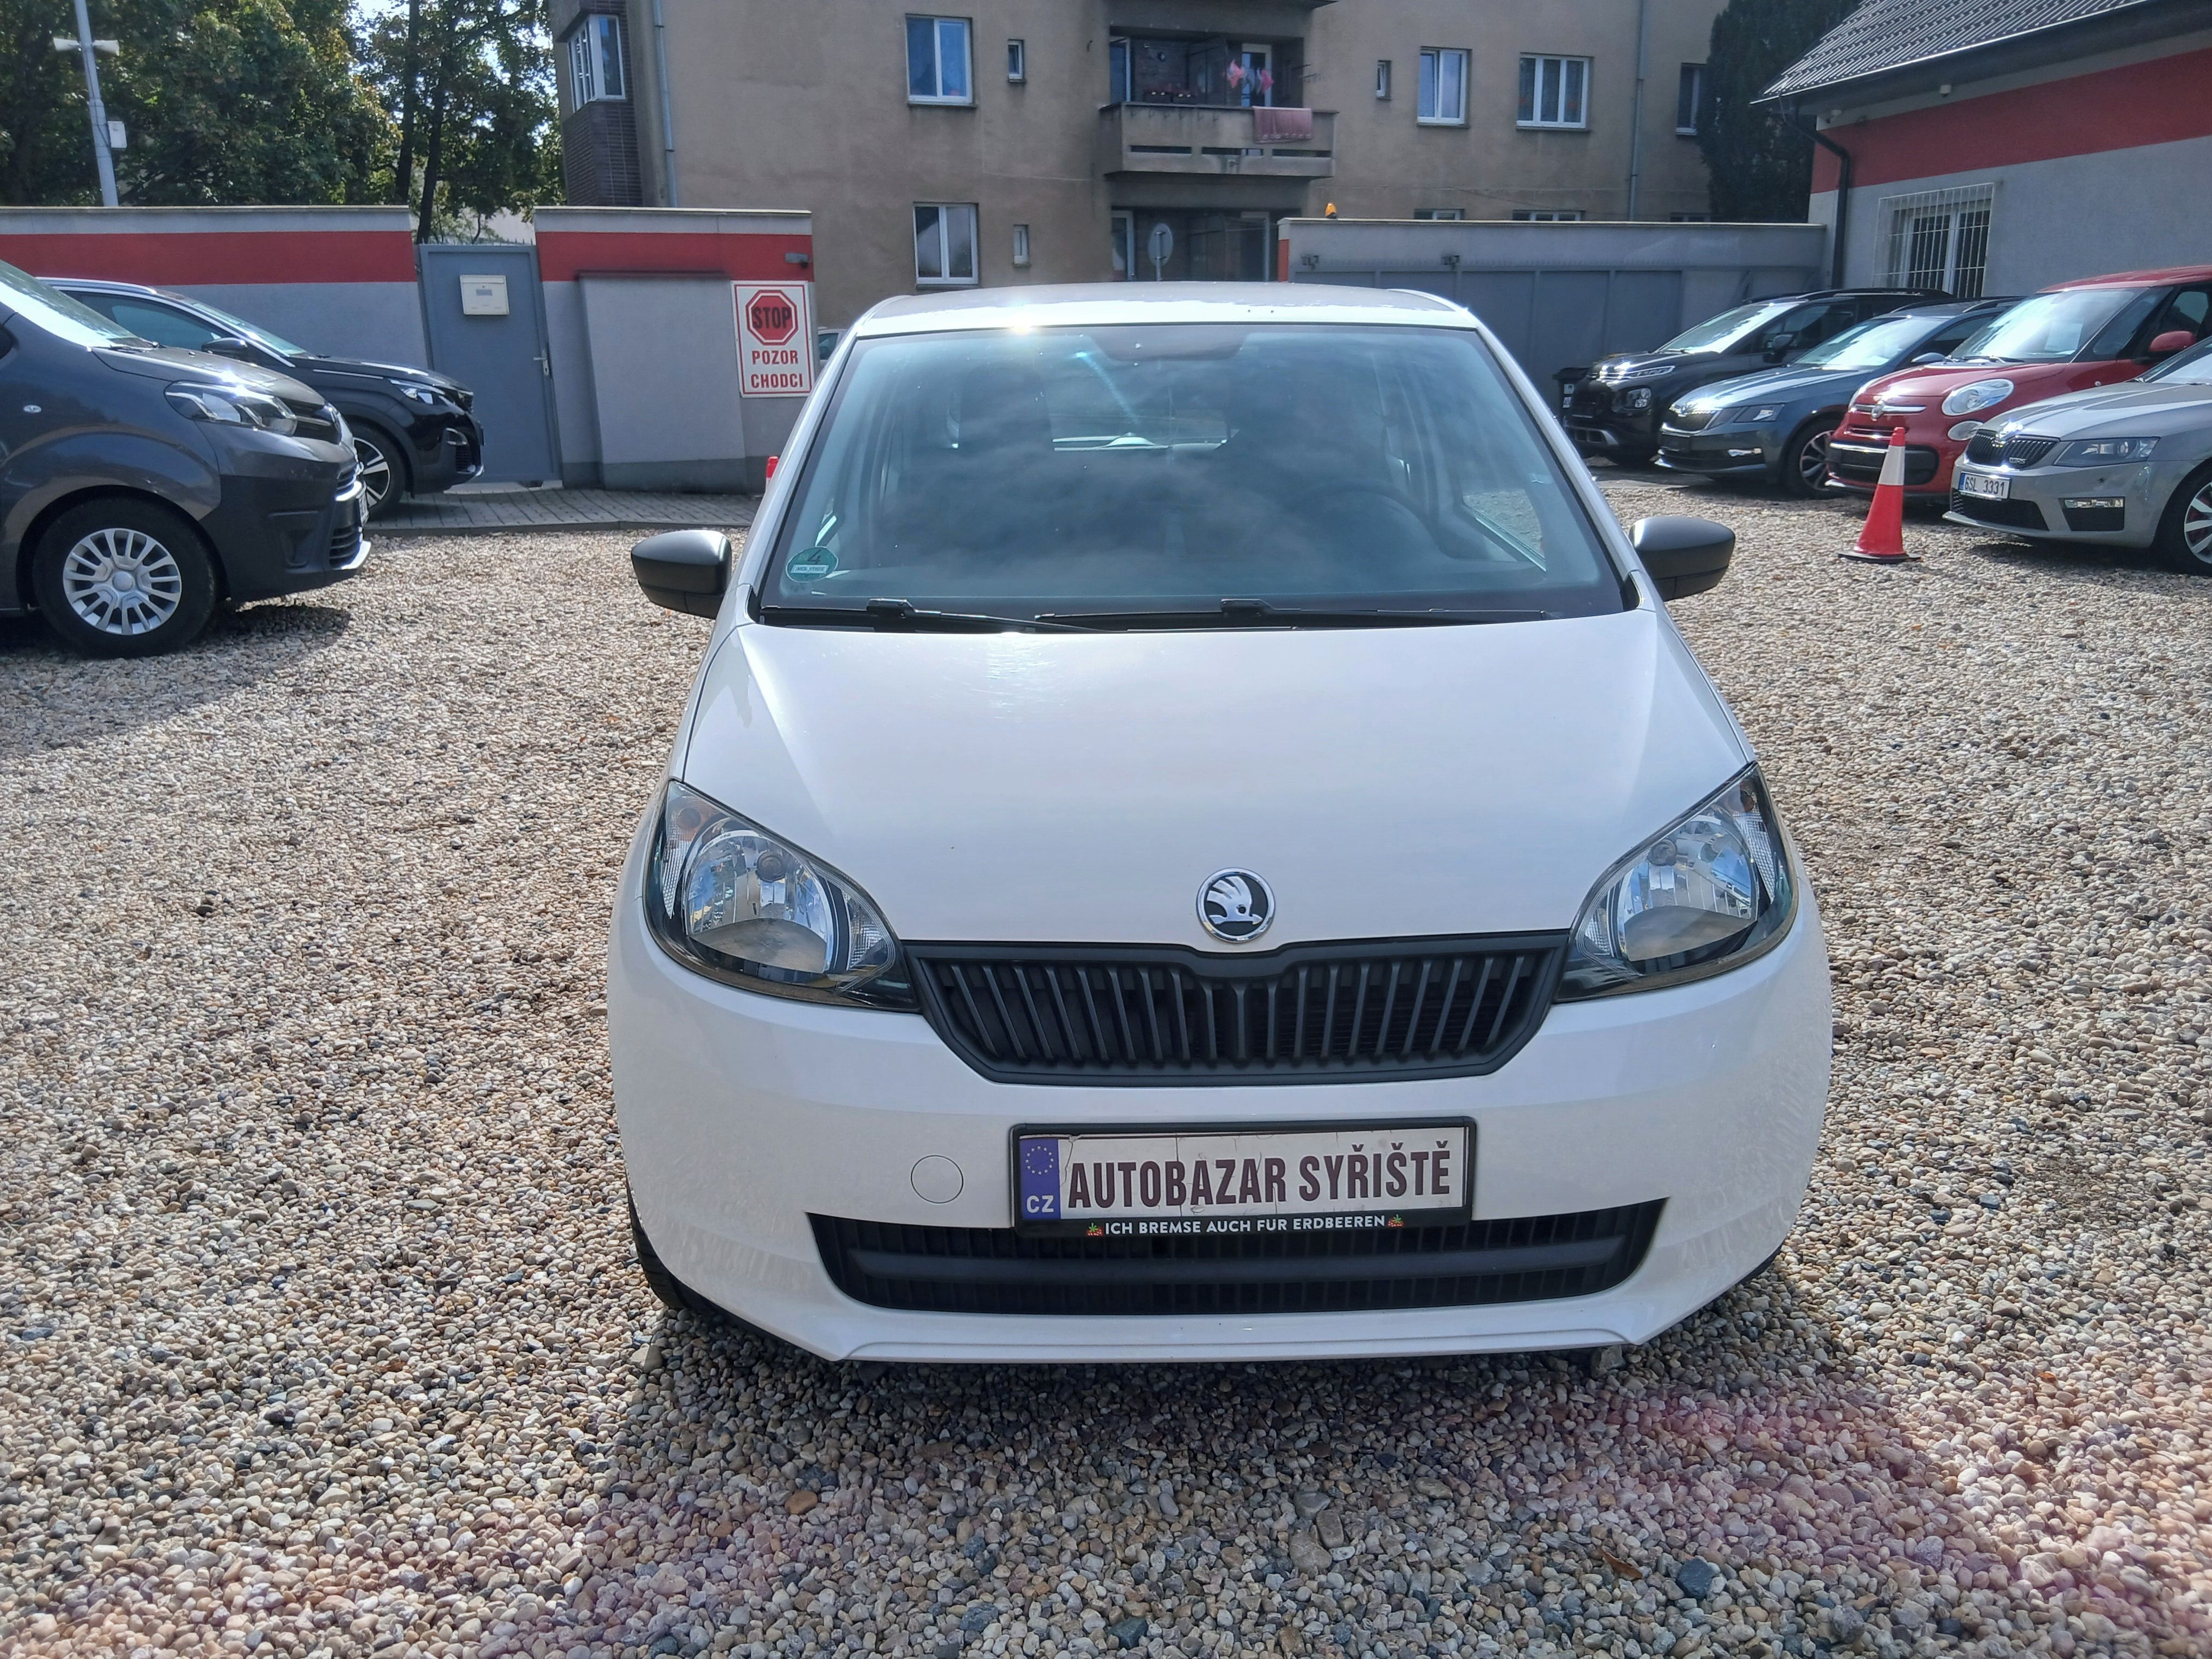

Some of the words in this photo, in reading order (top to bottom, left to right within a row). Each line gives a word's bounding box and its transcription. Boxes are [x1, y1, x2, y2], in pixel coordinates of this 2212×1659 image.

[753, 307, 792, 329] STOP
[751, 350, 799, 365] POZOR
[750, 373, 803, 389] CHODCI
[1964, 476, 1977, 492] 6SL
[1983, 479, 2005, 496] 3331
[807, 549, 822, 564] 4
[1068, 1158, 1287, 1208] AUTOBAZAR
[1298, 1140, 1450, 1201] SYŘIŠTĚ
[1026, 1194, 1054, 1213] CZ
[1105, 1221, 1133, 1235] ICH
[1139, 1220, 1201, 1234] BREMSE
[1206, 1219, 1251, 1232] AUCH
[1257, 1218, 1288, 1232] FÜR
[1293, 1215, 1385, 1230] ERDBEEREN
